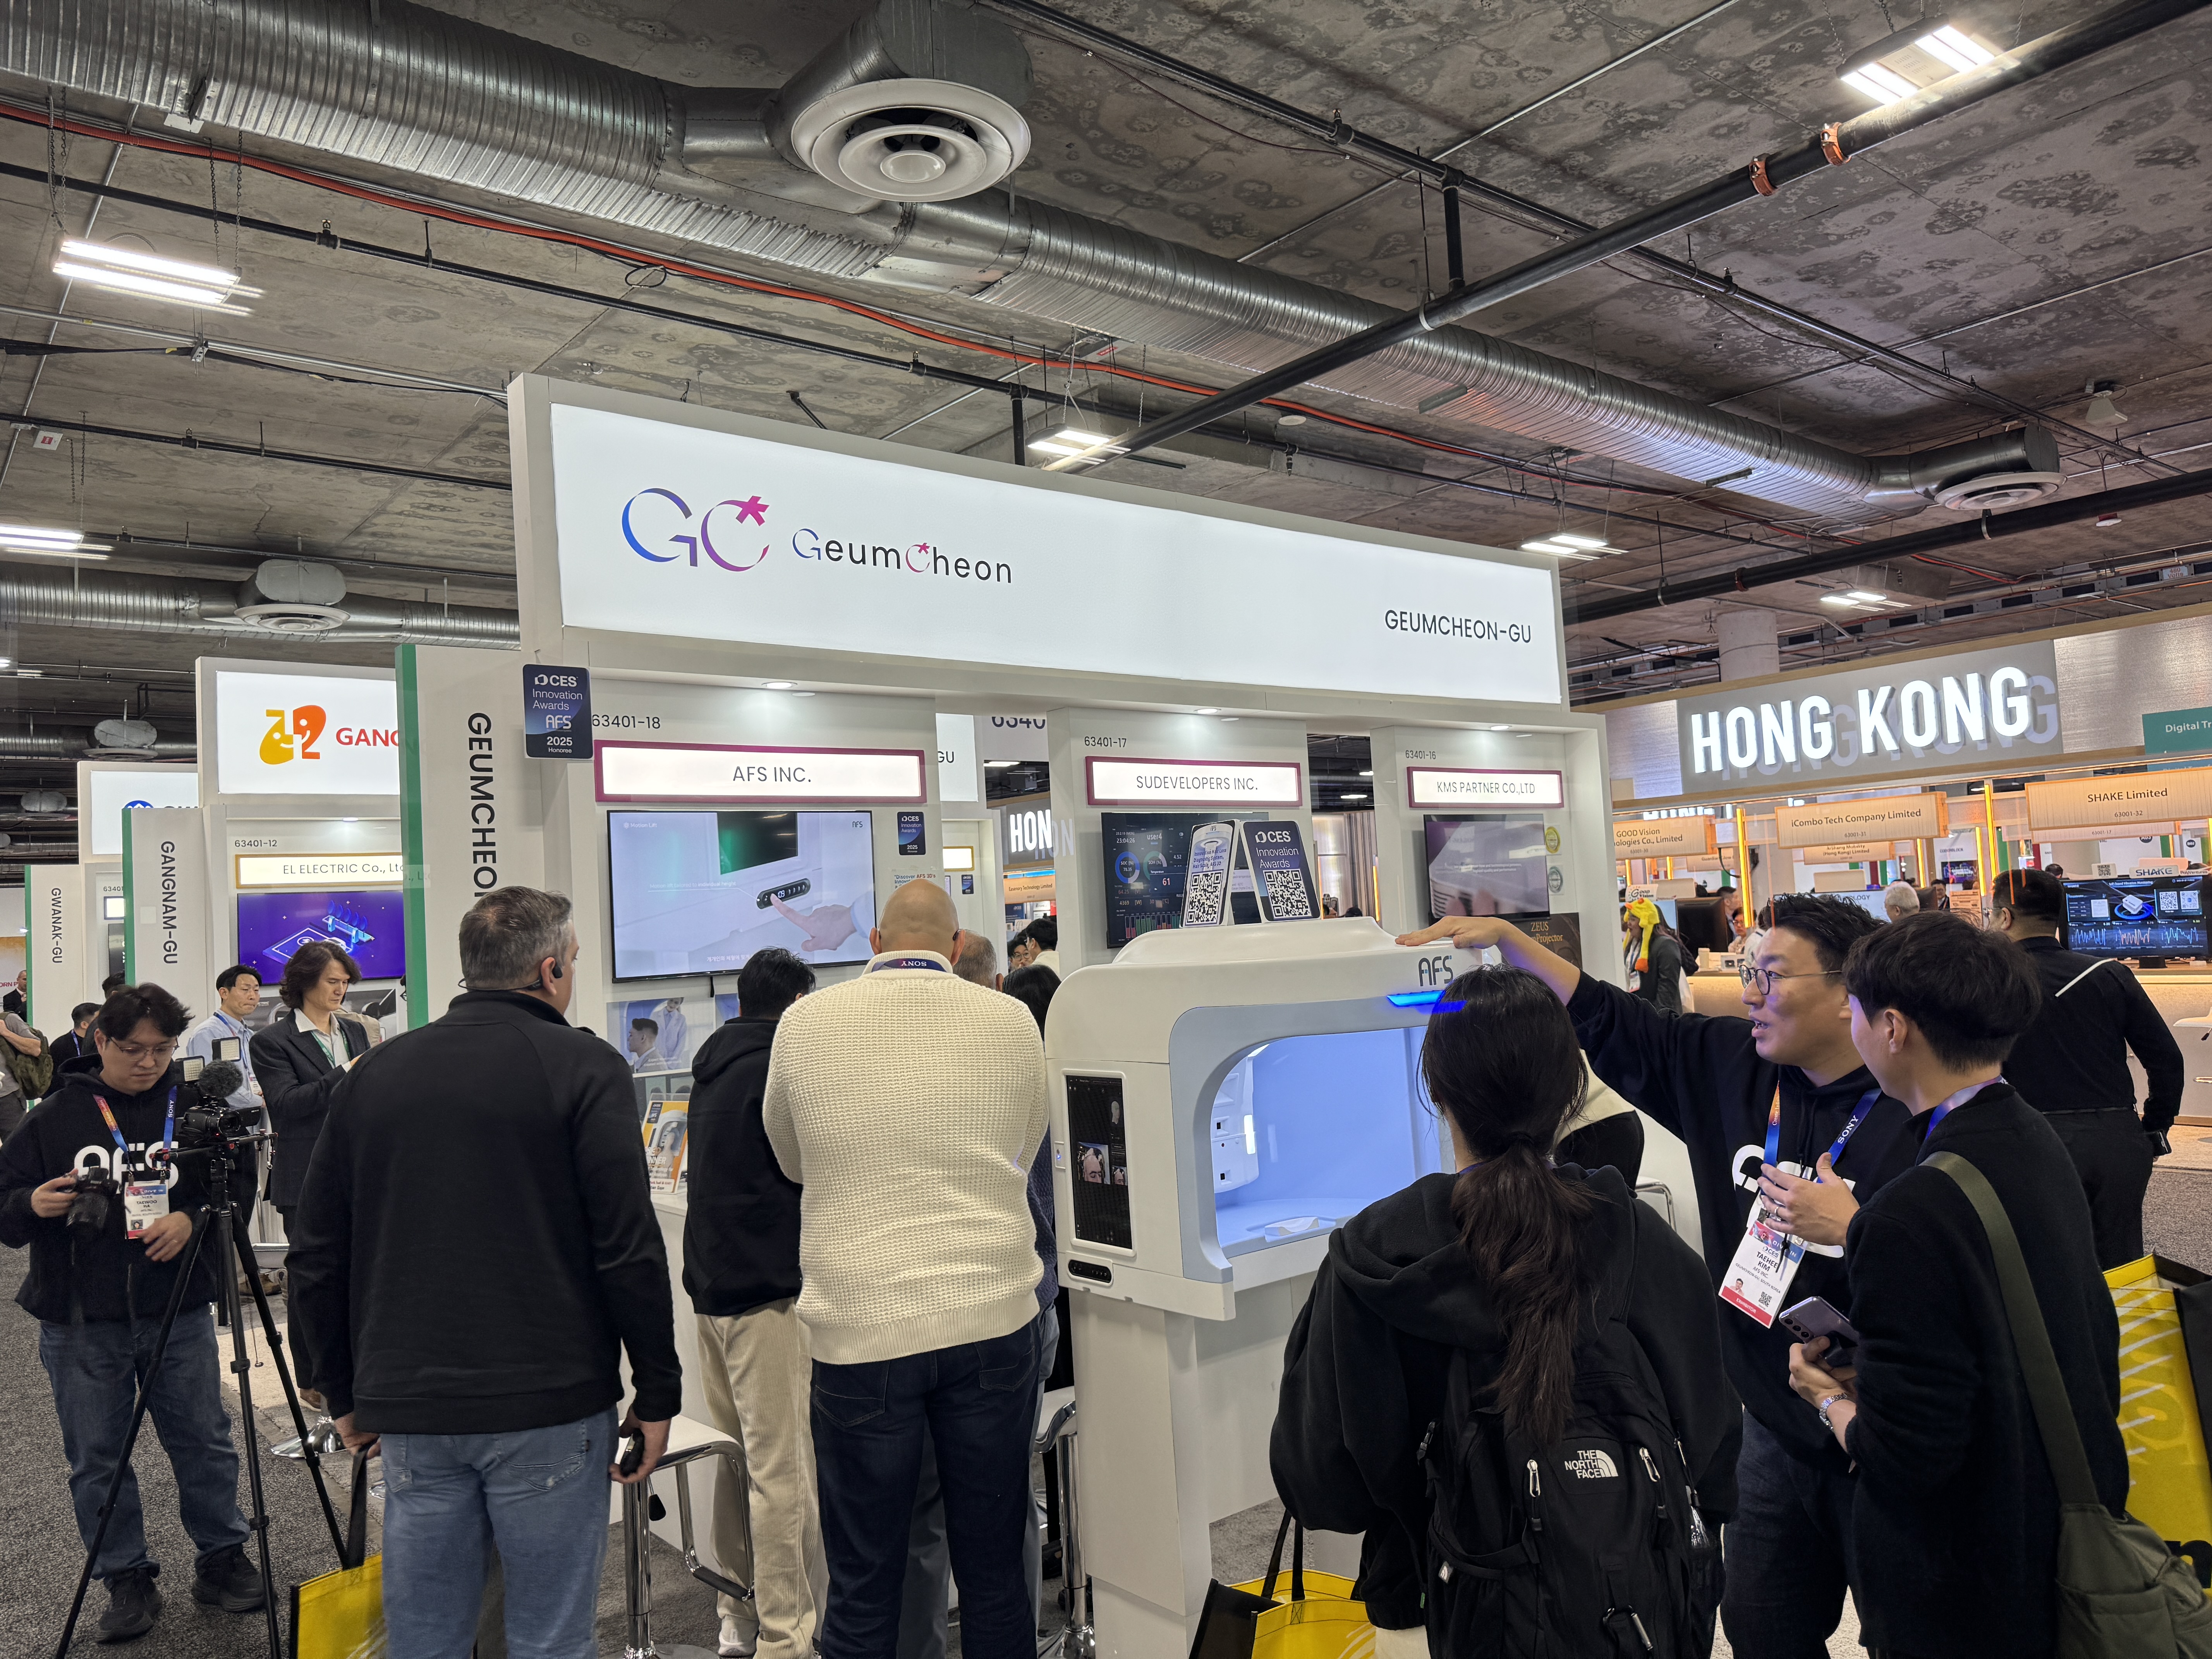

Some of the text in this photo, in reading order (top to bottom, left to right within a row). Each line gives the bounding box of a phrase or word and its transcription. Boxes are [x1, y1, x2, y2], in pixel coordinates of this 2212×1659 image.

[792, 528, 1012, 583] GeumCheon
[1385, 610, 1531, 643] GEUMCHEON-GU
[550, 675, 577, 687] CES
[533, 689, 582, 700] Innovation
[533, 700, 569, 710] Awards
[546, 714, 572, 729] AFS
[592, 714, 661, 729] 63401-18
[1691, 666, 2030, 774] HONG KONG
[2165, 721, 2200, 733] Digital
[547, 737, 573, 746] 2025
[1085, 736, 1127, 748] 63401-17
[1405, 750, 1436, 760] 63401-16
[733, 766, 811, 783] AFS INC.
[1136, 776, 1258, 790] SUDEVELOPERS INC.
[1437, 781, 1535, 795] KMS PARTNER CO.,LTD
[2087, 788, 2168, 802] SHAKE Limited
[468, 712, 497, 897] GEUMCHEO
[1791, 808, 1921, 827] iCombo Tech Company Limited
[1267, 831, 1291, 843] CES
[1639, 828, 1660, 836] Vision
[1656, 834, 1683, 843] Limited
[1256, 847, 1299, 857] Innovation
[283, 865, 295, 874] EL
[300, 864, 358, 874] ELECTRIC
[362, 864, 385, 874] Co.,
[1260, 859, 1290, 868] Awards
[2135, 867, 2172, 876] SHAKE
[1163, 878, 1171, 886] 61
[161, 841, 178, 964] GANGNAM-GU
[51, 888, 62, 963] GWANAK-GU
[1530, 921, 1549, 932] ZEUS
[1418, 955, 1454, 987] AFS
[1838, 1115, 1859, 1144] SONY
[1772, 1240, 1784, 1249] DIV
[1768, 1248, 1779, 1258] CES
[1757, 1251, 1778, 1268] TAEHEE
[1758, 1261, 1770, 1272] KIM
[1577, 1450, 1595, 1460] THE
[1565, 1460, 1598, 1470] NORTH
[1576, 1470, 1601, 1479] FACE
